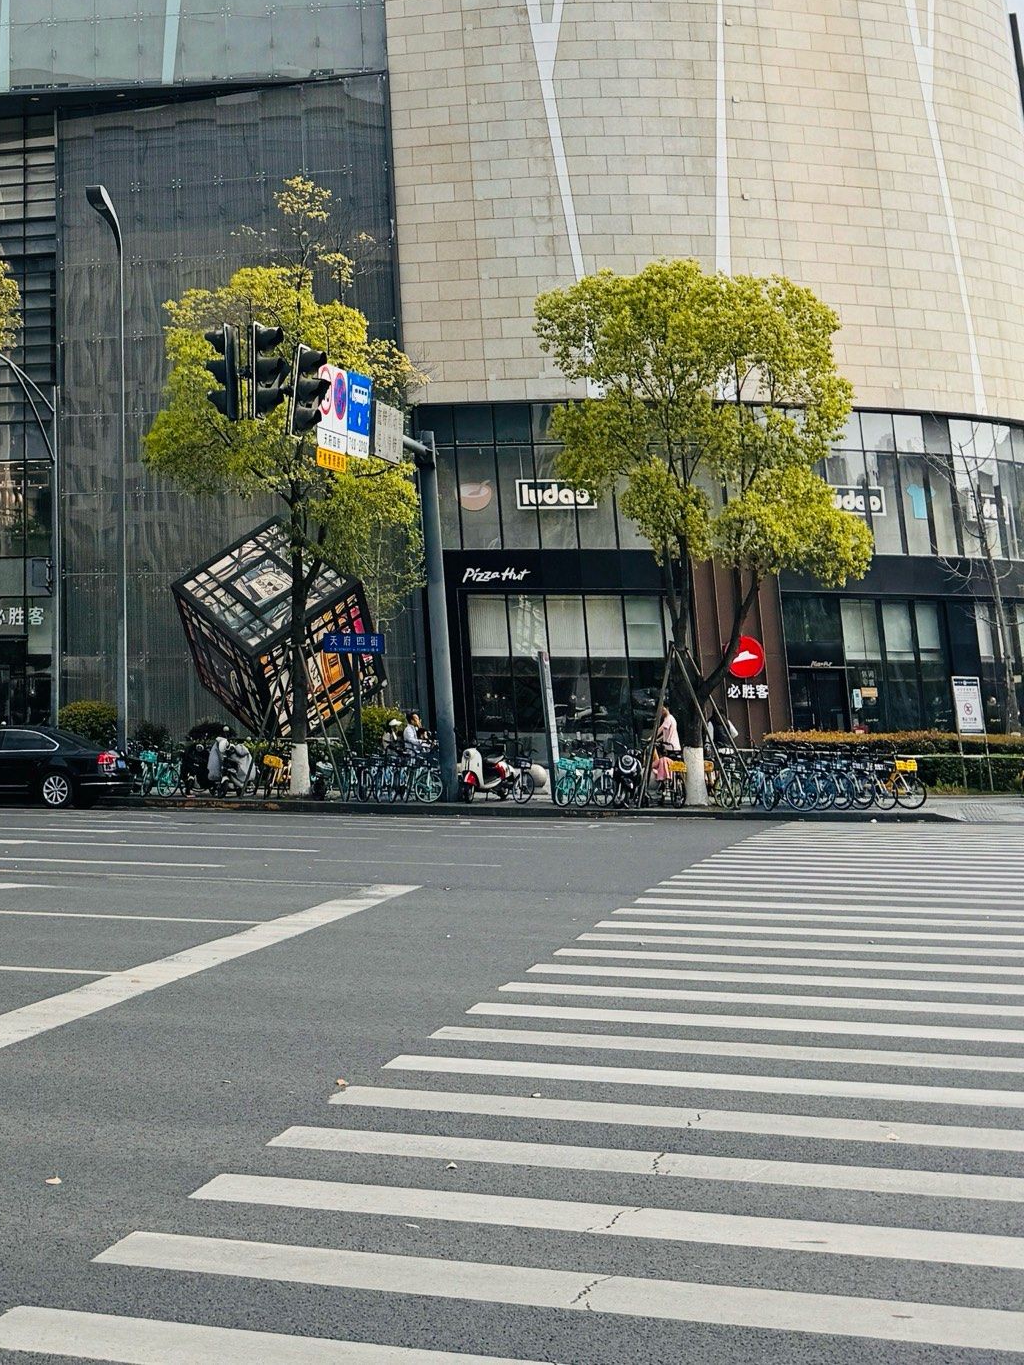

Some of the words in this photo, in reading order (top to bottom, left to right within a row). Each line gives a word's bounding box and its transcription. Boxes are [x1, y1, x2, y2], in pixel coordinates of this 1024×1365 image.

[833, 490, 881, 511] udao
[462, 567, 500, 583] Pizza
[501, 567, 531, 581] Hut
[329, 635, 378, 647] 天府四街
[727, 684, 769, 700] 必胜客
